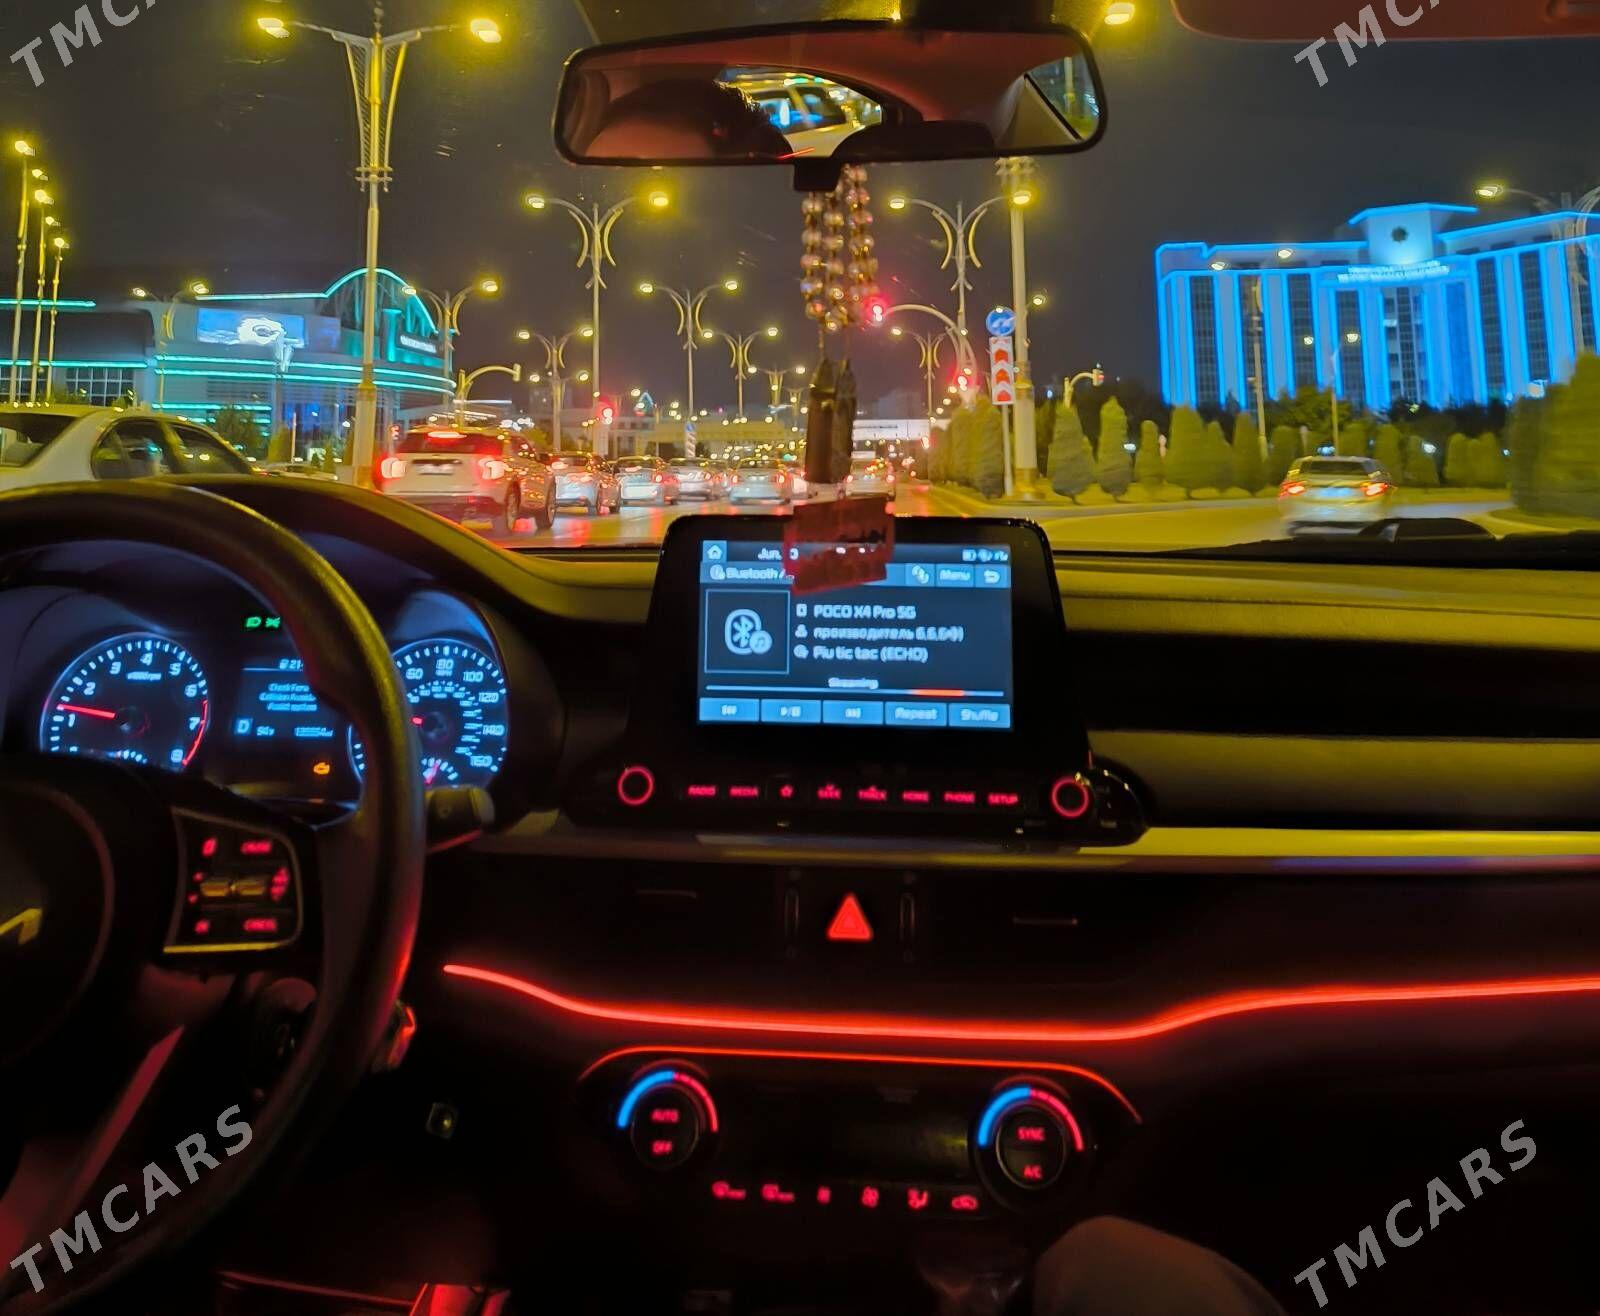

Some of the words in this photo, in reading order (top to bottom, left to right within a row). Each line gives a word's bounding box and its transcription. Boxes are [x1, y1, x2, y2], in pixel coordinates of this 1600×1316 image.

[813, 604, 853, 619] POCO
[853, 604, 872, 619] X4
[872, 605, 897, 620] Pro
[140, 652, 153, 666] 4
[835, 645, 854, 660] tic
[109, 661, 122, 675] 3
[169, 662, 182, 676] 5
[463, 671, 484, 682] 100
[83, 682, 96, 696] 2
[184, 684, 197, 698] 6
[478, 691, 499, 703] 120
[68, 713, 76, 729] 1
[188, 716, 201, 731] 7
[651, 1108, 679, 1122] AUTO
[1017, 1126, 1045, 1141] SYNC
[653, 1139, 673, 1154] OFF
